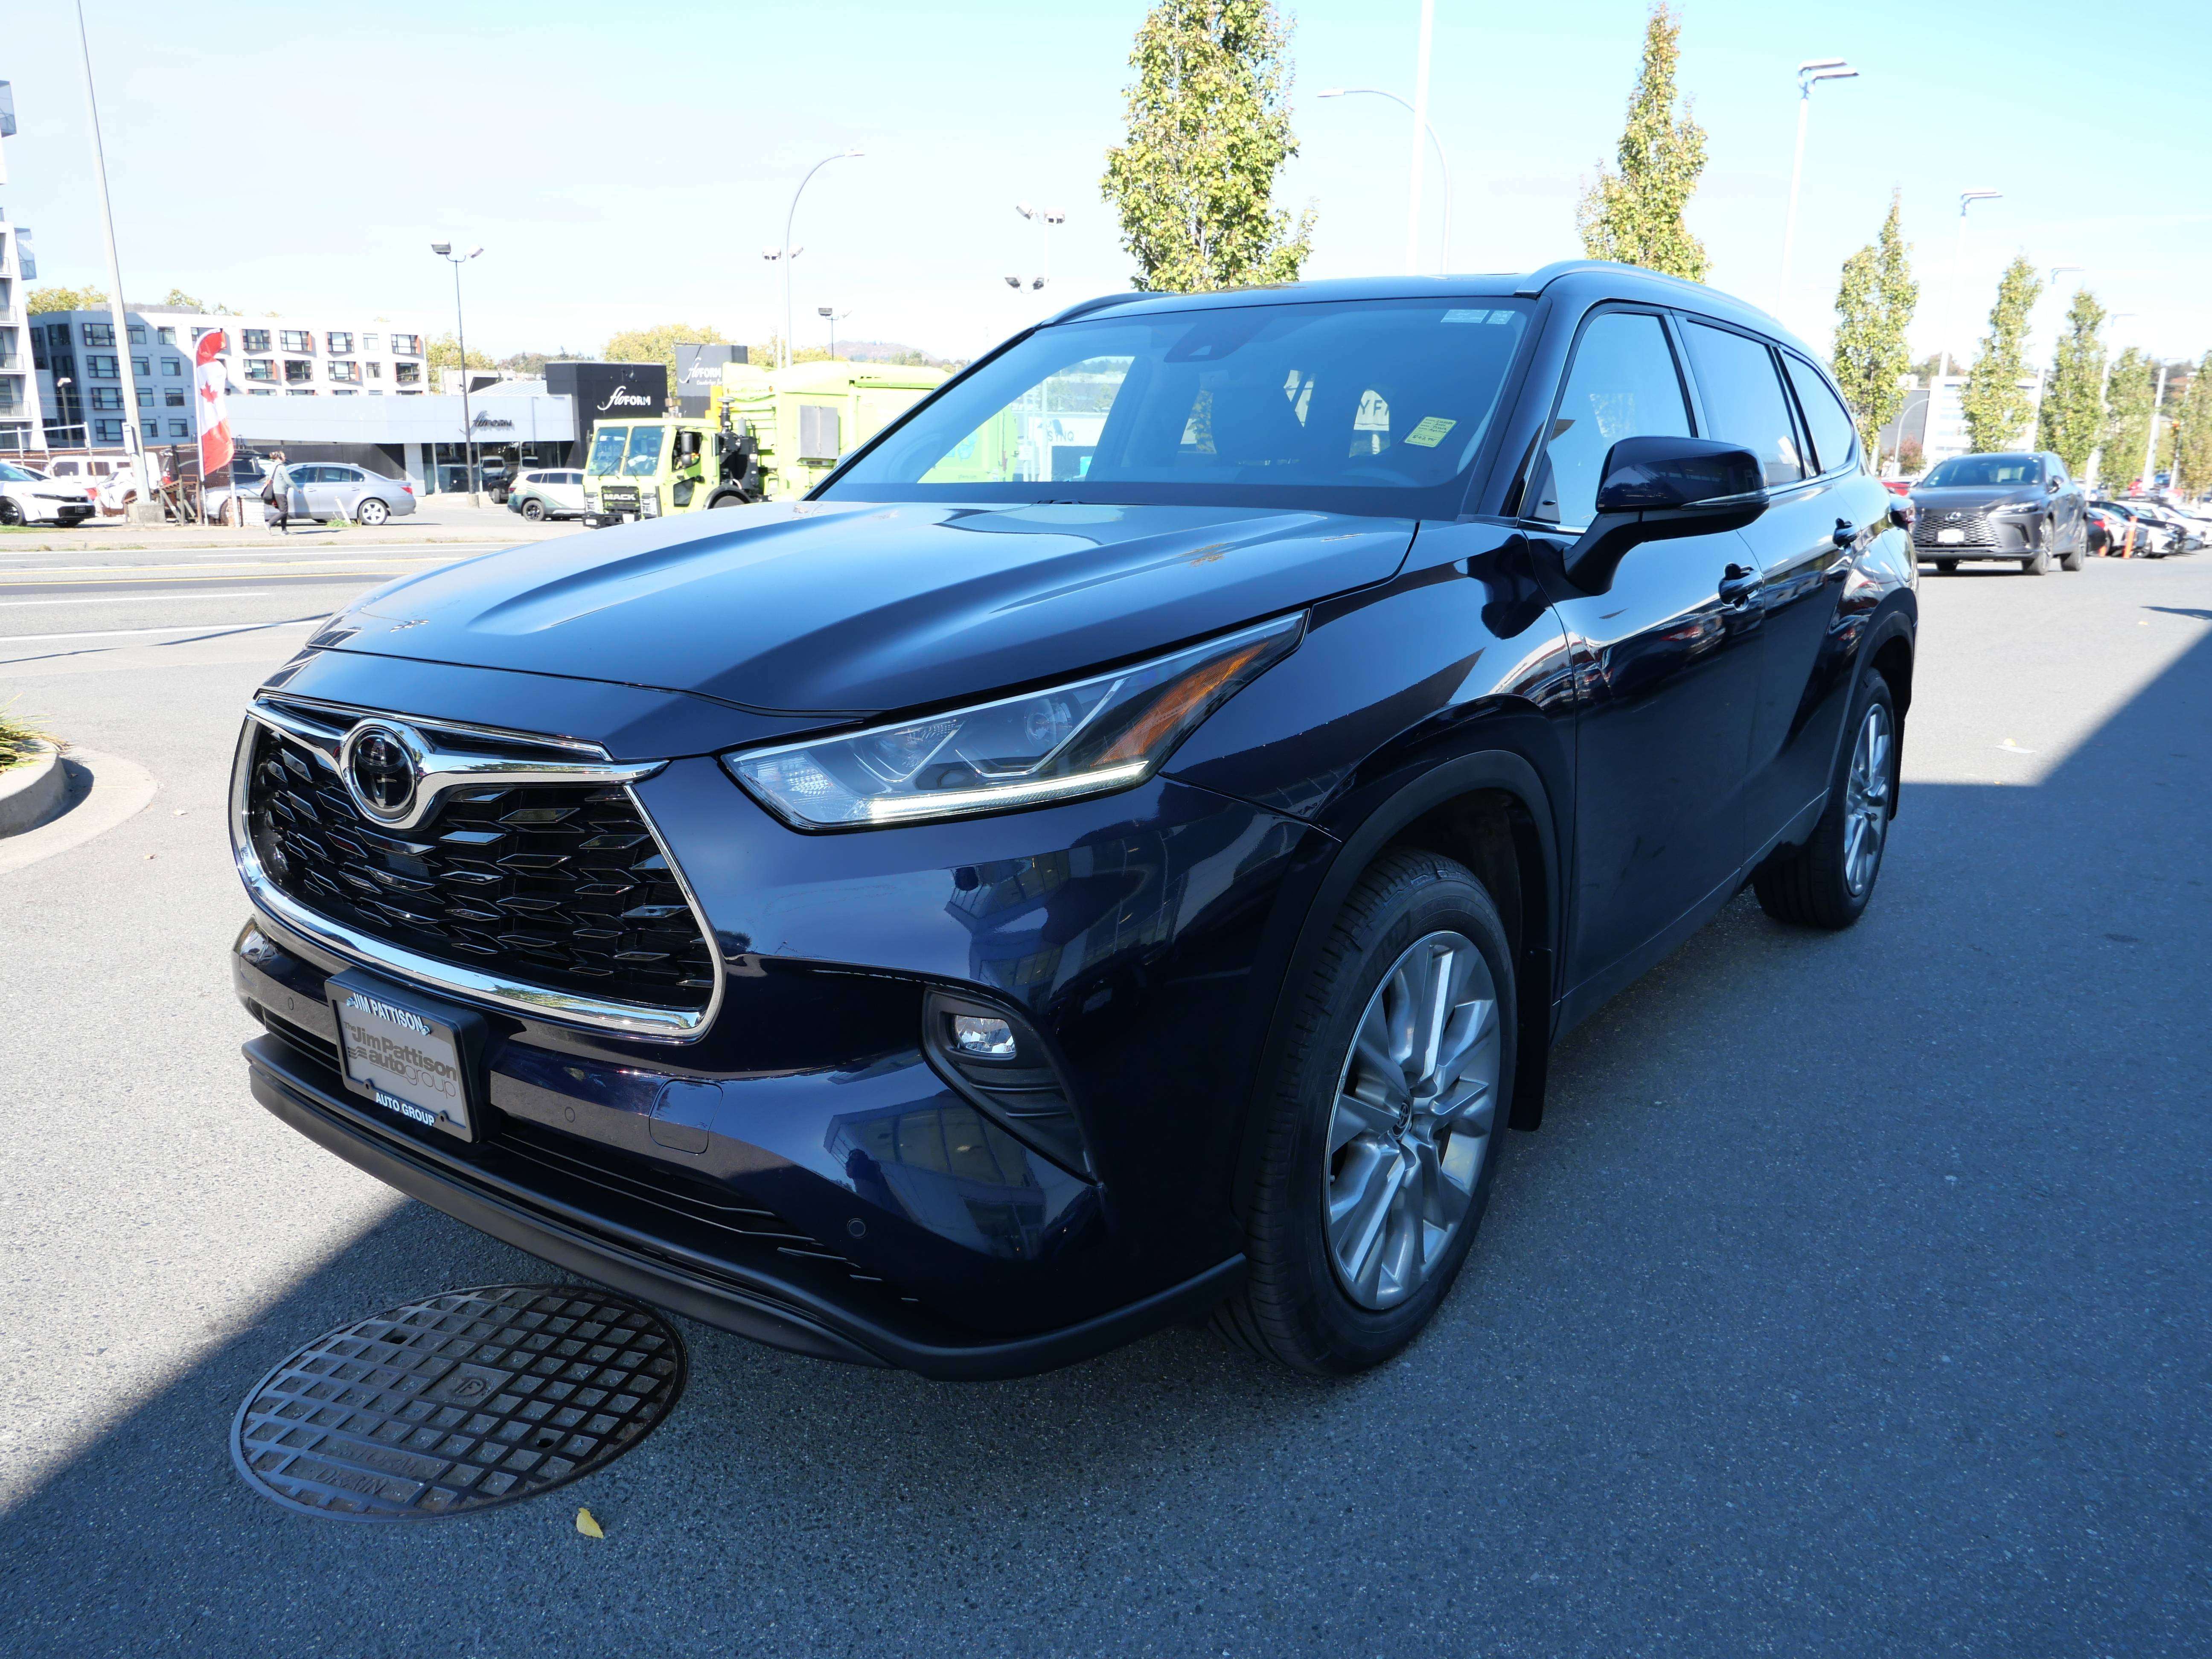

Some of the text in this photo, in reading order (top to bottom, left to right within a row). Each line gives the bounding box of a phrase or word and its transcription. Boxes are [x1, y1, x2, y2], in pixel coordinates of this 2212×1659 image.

[597, 386, 651, 410] floFORM
[353, 992, 424, 1032] JIM PATTISON
[343, 1022, 357, 1032] The
[376, 1092, 435, 1126] AUTO GROUP
